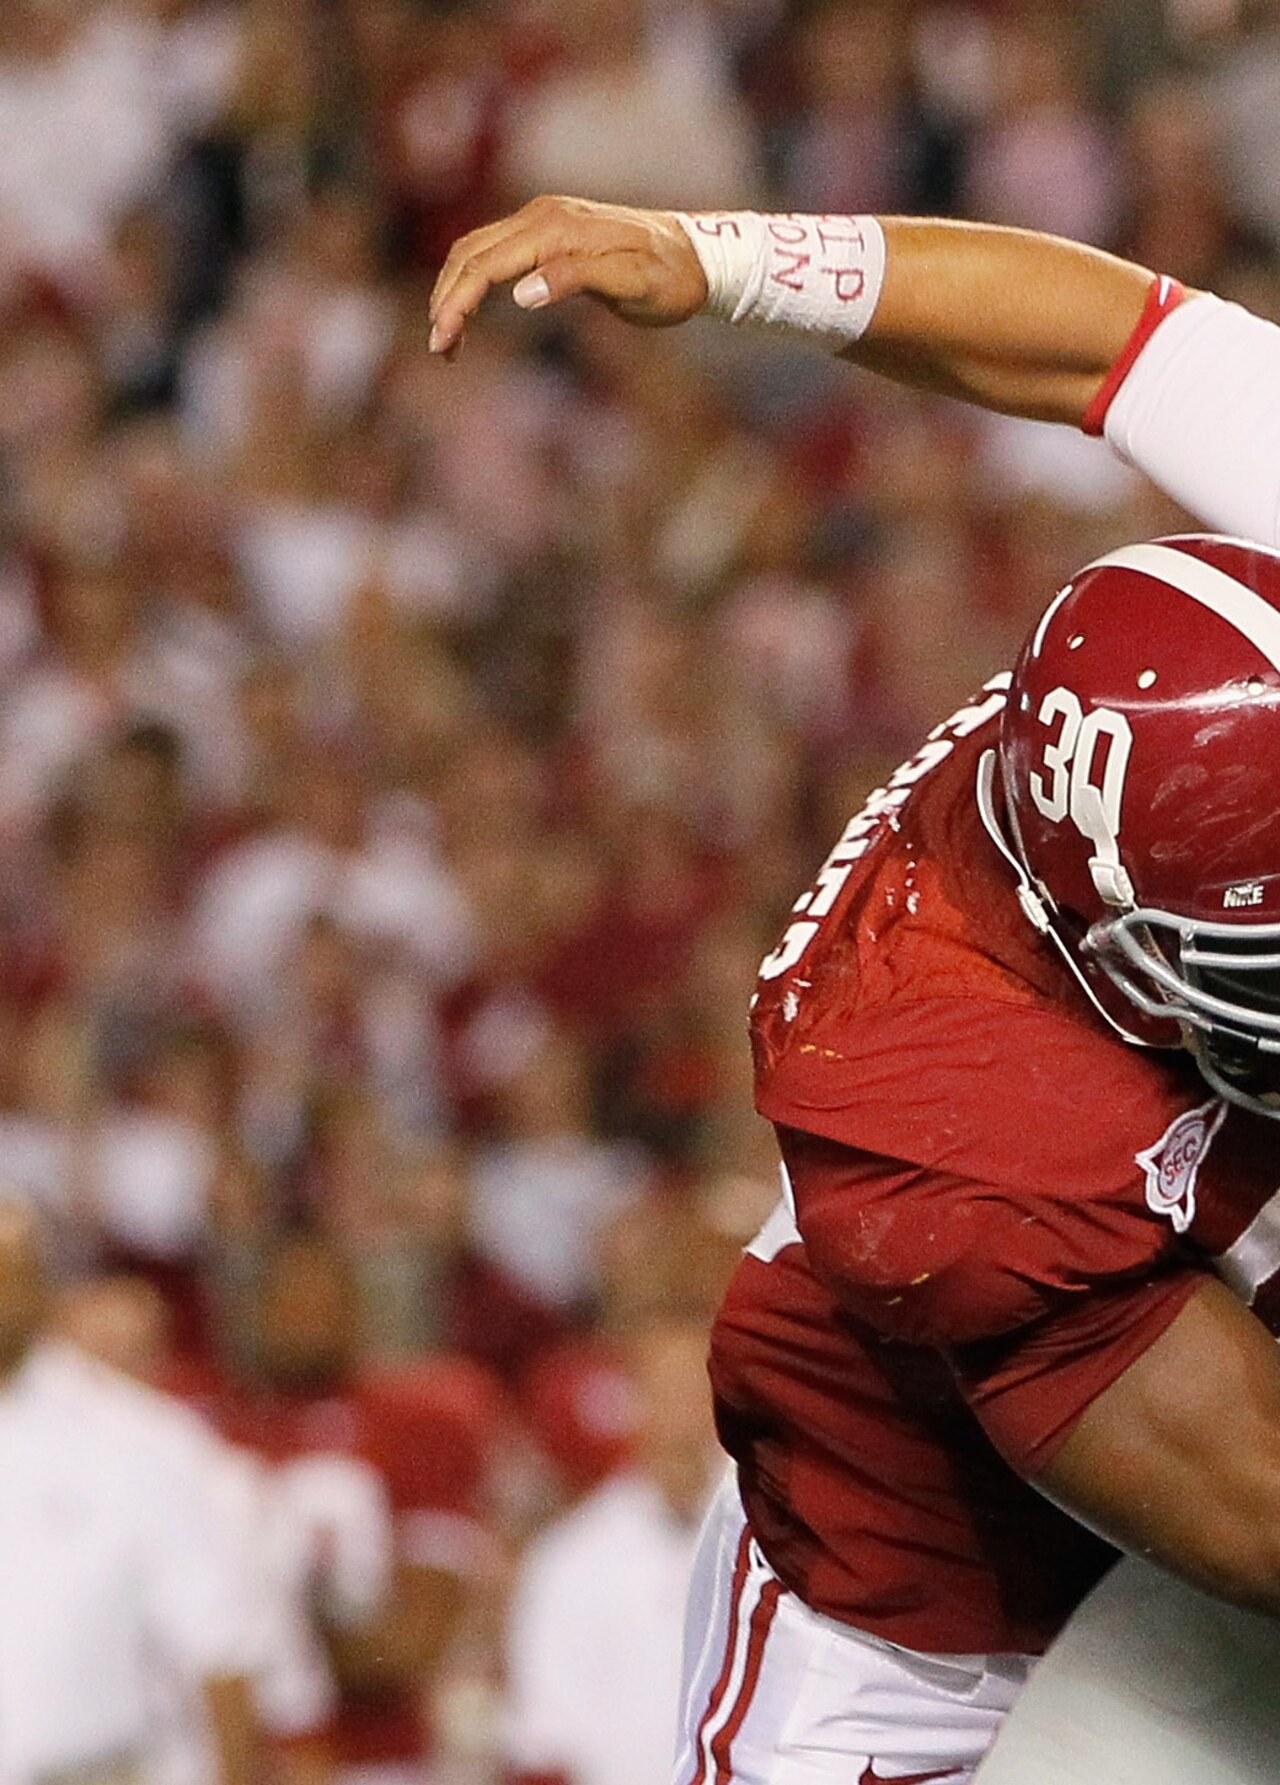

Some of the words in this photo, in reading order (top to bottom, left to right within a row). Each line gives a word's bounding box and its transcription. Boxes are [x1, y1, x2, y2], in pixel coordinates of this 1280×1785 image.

[694, 218, 741, 239] 5
[1029, 685, 1134, 845] 30
[1164, 1136, 1200, 1187] SEC
